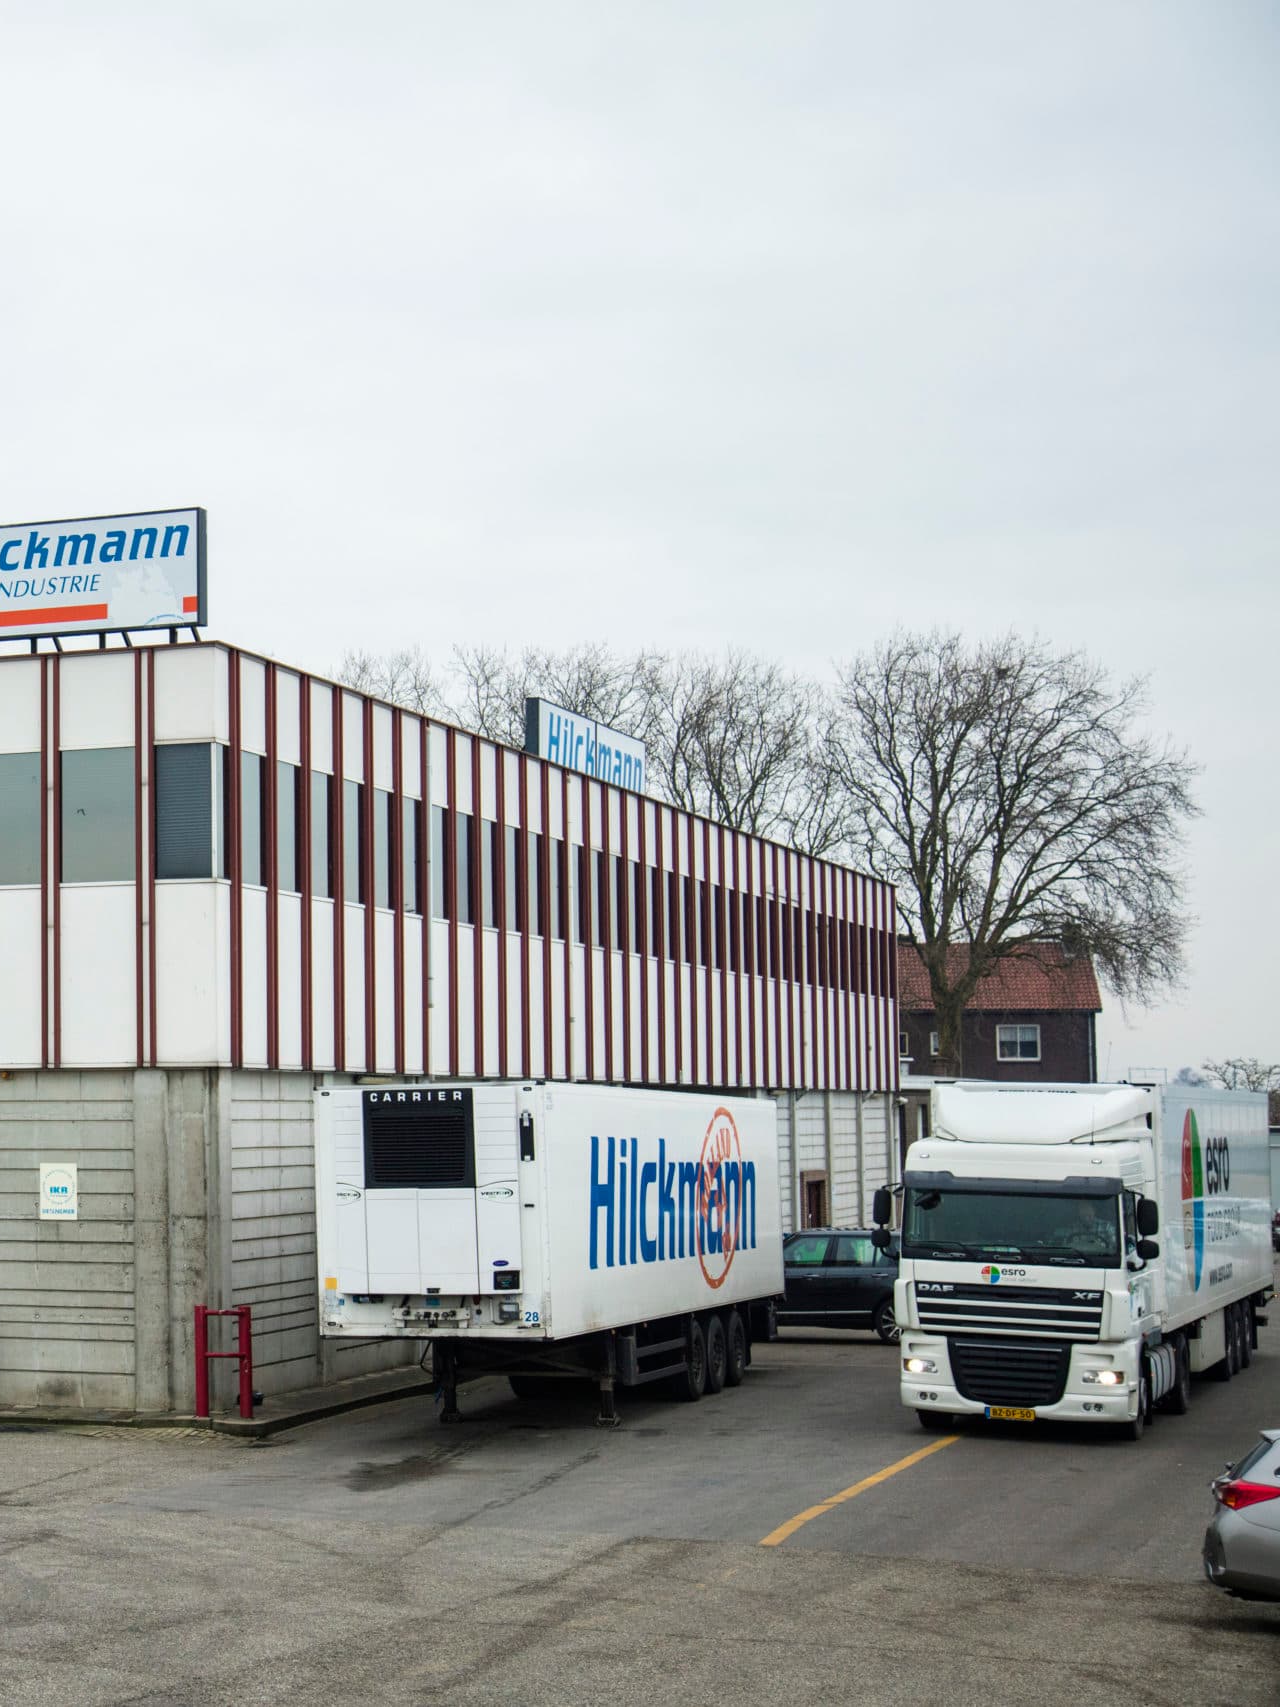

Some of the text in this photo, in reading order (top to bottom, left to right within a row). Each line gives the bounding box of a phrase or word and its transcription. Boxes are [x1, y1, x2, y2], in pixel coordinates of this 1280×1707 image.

[547, 711, 642, 793] Hilckmann
[369, 1090, 463, 1102] CARRIER
[1206, 1136, 1230, 1194] esro
[589, 1136, 757, 1270] Hilckmann
[1001, 1268, 1026, 1277] esro
[917, 1283, 955, 1293] DAF
[1072, 1292, 1102, 1300] XF
[525, 1311, 539, 1322] 28
